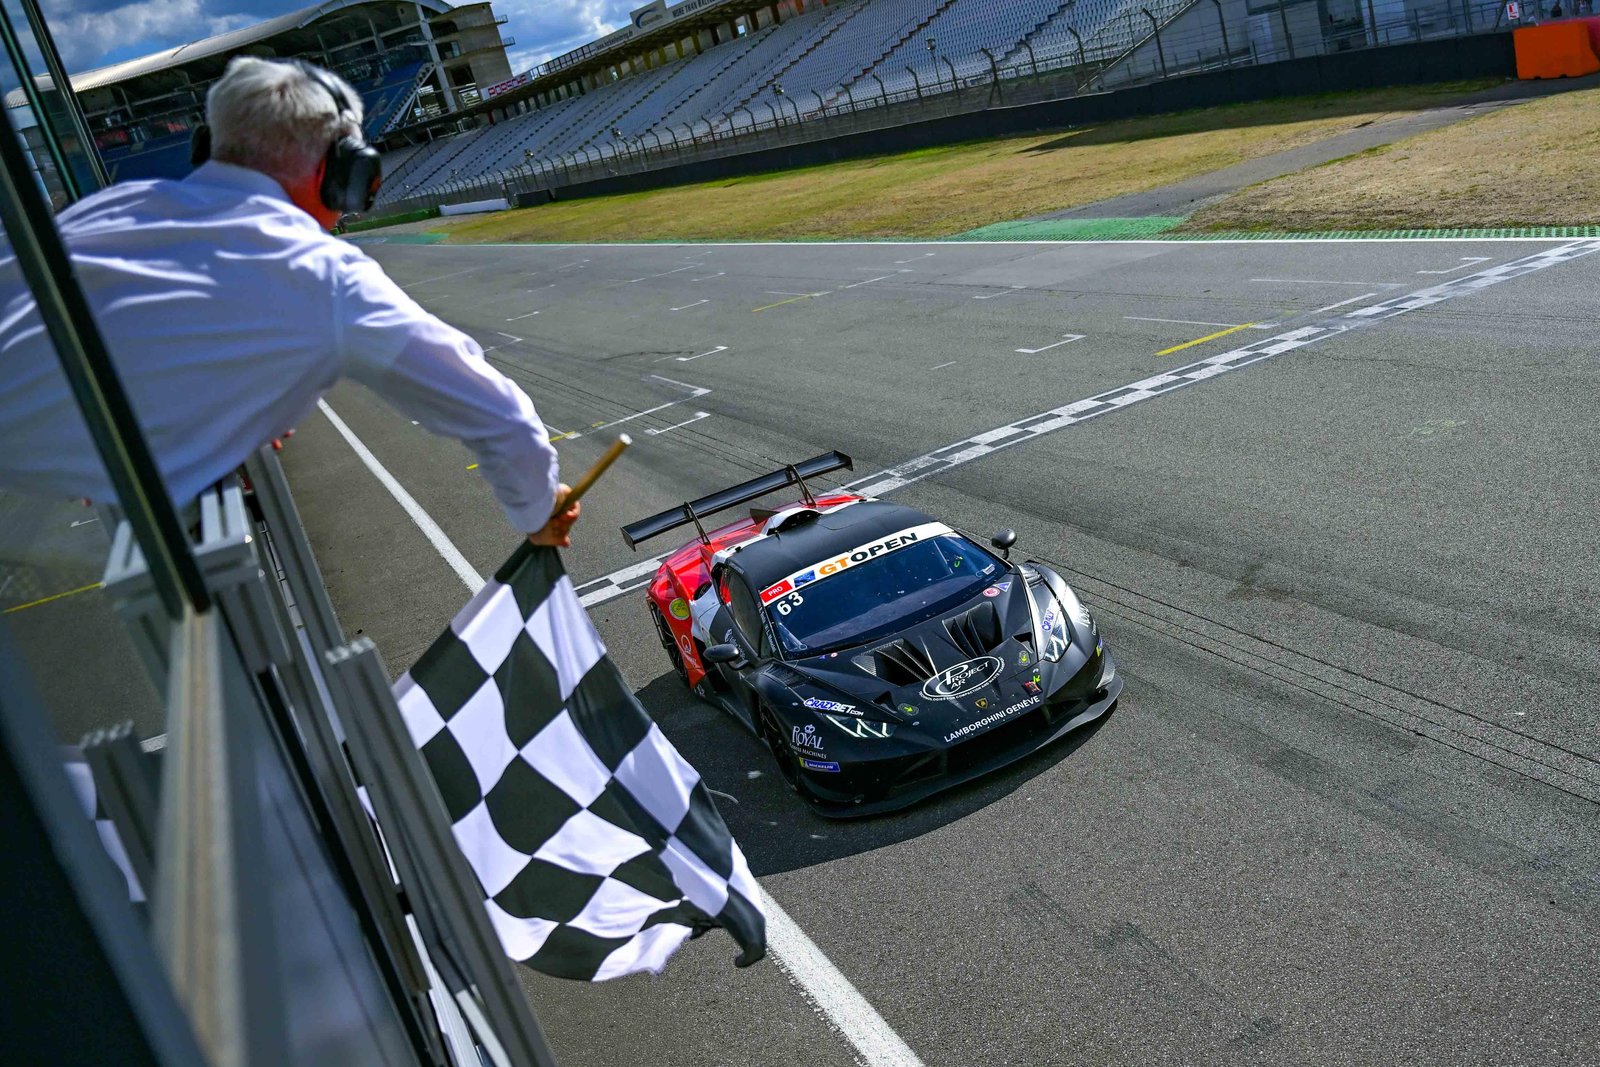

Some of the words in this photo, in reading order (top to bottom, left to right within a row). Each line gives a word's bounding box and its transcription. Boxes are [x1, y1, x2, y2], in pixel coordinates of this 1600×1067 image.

[488, 74, 527, 96] PORSCHE
[768, 586, 783, 596] PRO
[777, 592, 804, 616] 63
[944, 661, 990, 686] PROJECT
[792, 725, 824, 750] ROYAL
[944, 710, 1006, 743] LAMBORGHINI
